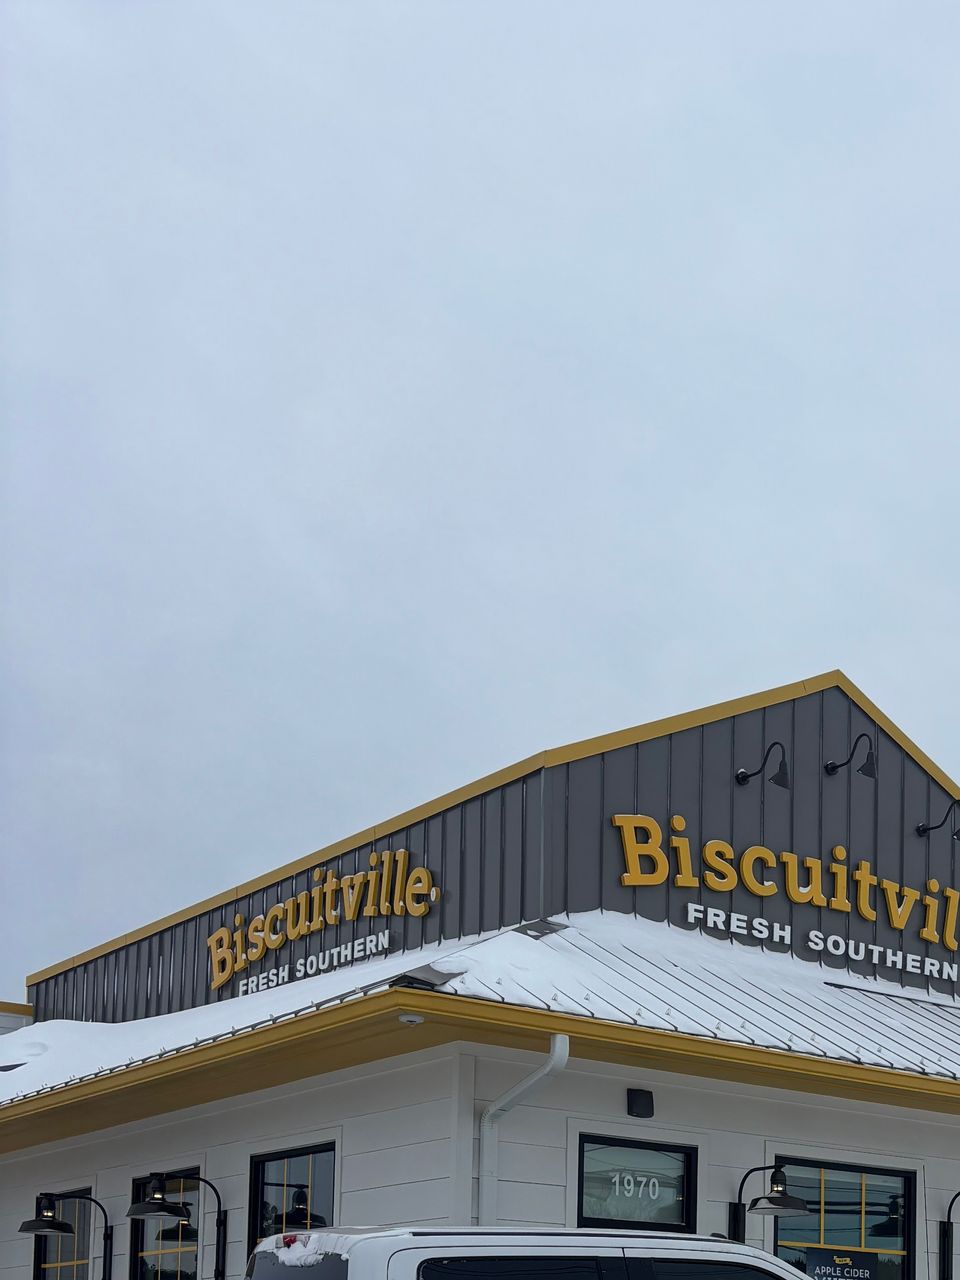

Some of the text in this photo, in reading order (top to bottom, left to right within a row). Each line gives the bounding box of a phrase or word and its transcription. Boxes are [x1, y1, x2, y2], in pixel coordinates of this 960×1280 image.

[207, 849, 434, 990] Biscuitville
[687, 902, 958, 982] FRESH SOUTHERN
[238, 929, 390, 997] FRESH SOUTHERN
[612, 1174, 659, 1200] 1970
[814, 1266, 870, 1278] APPLE CIDER
